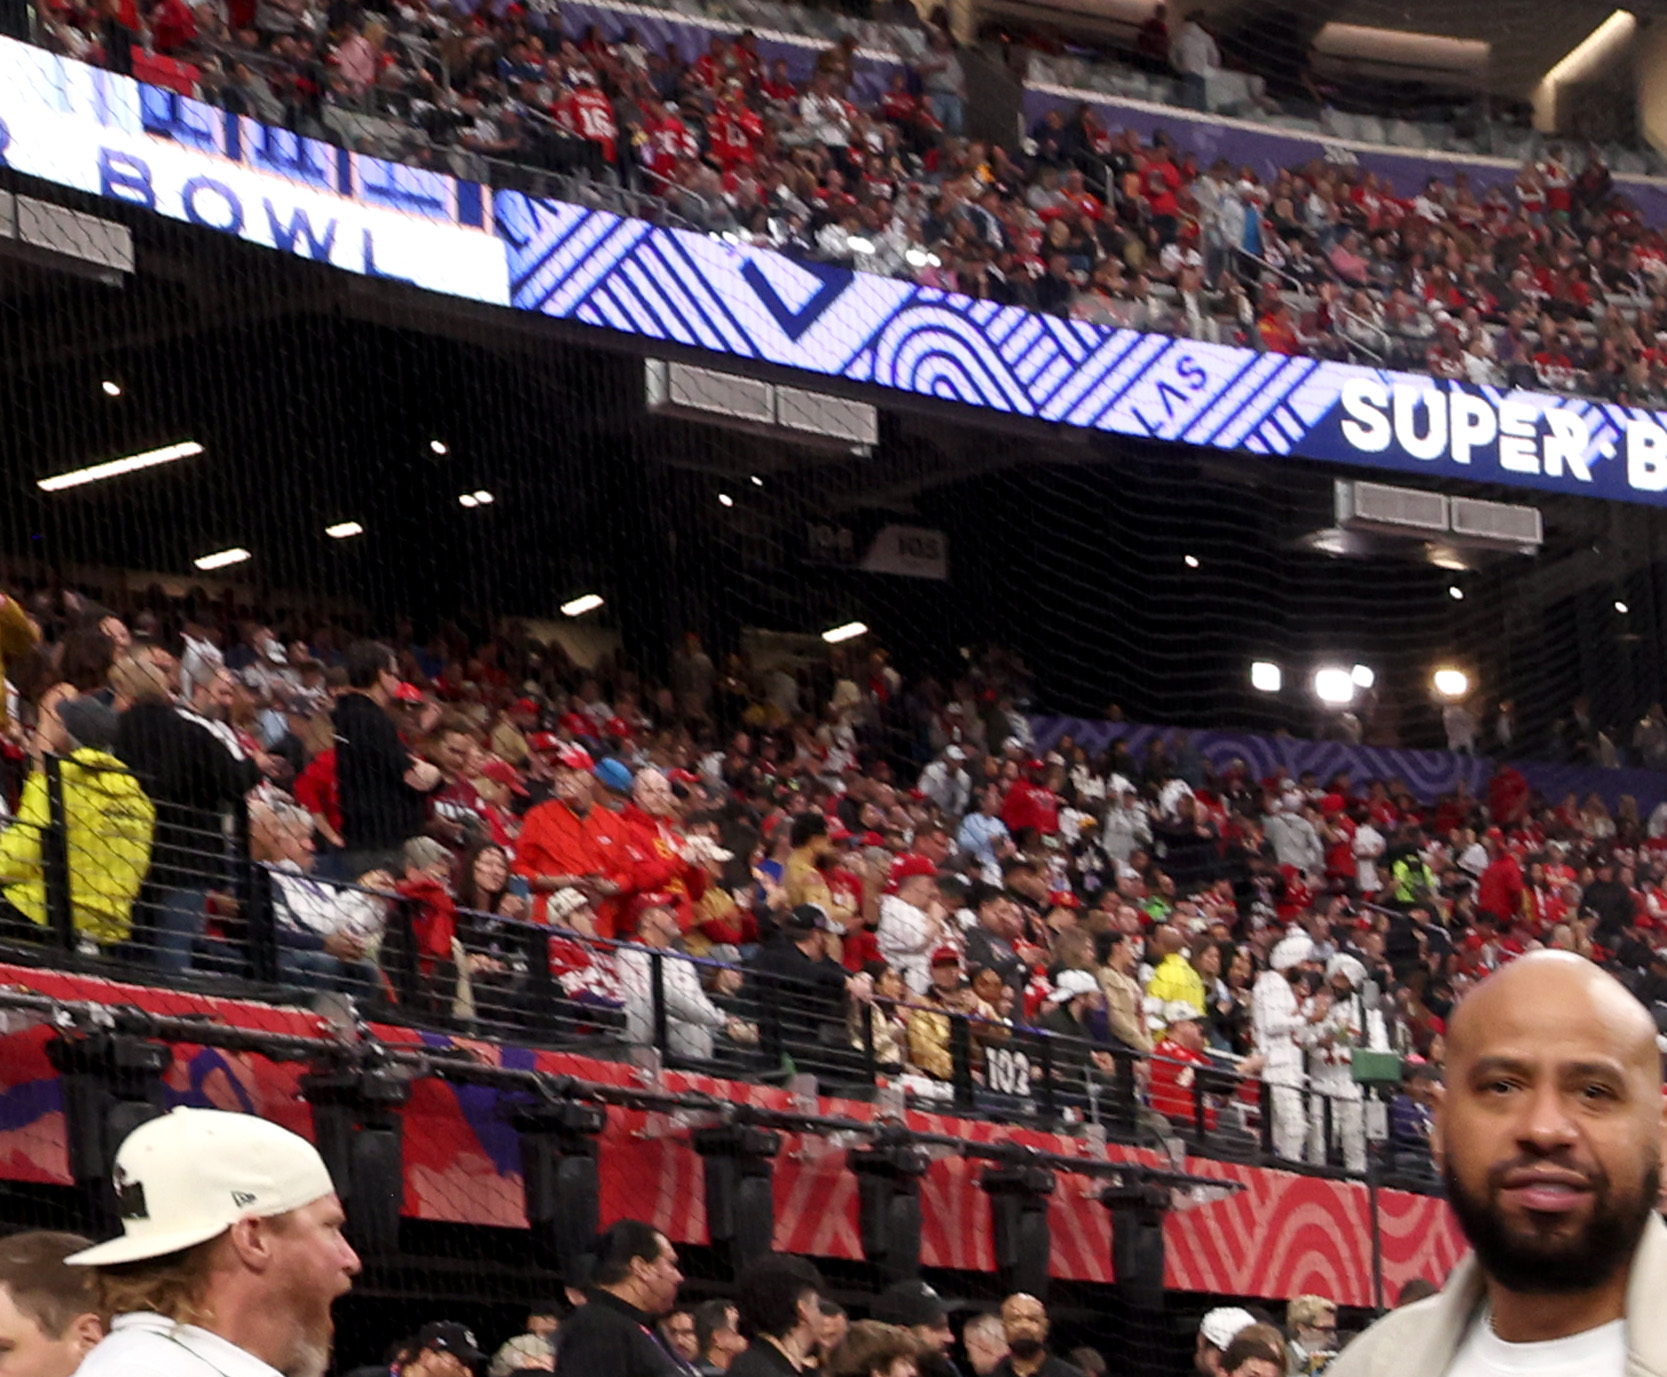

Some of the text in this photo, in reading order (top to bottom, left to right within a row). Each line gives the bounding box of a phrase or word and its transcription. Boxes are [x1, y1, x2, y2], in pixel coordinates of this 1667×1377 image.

[100, 146, 417, 285] BOWL
[1341, 376, 1593, 482] SUPER
[985, 1045, 1031, 1097] 102
